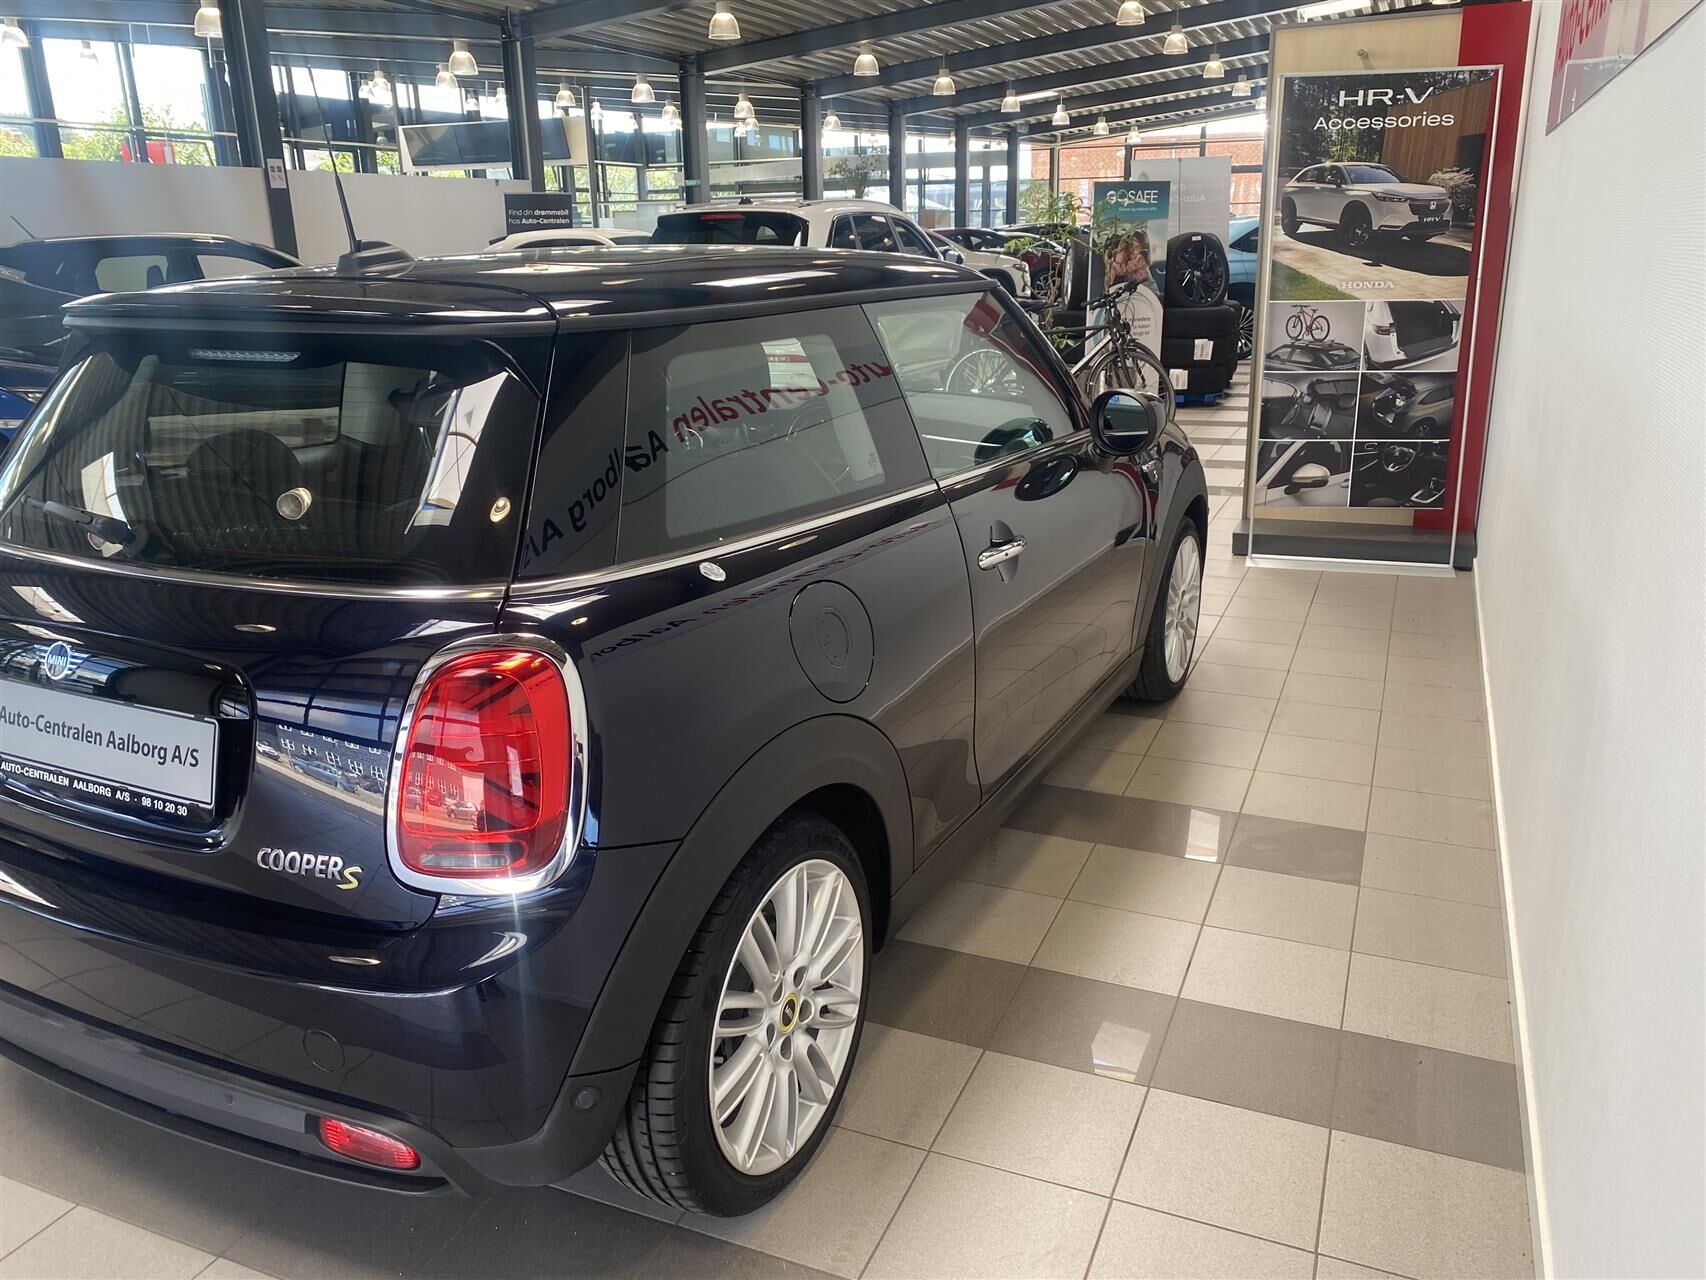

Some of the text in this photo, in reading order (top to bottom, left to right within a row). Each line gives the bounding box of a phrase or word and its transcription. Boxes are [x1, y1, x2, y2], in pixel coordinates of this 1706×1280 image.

[1338, 86, 1434, 107] HR-V
[1313, 111, 1455, 130] Accessories
[521, 217, 570, 225] Auto-Centralen
[1340, 280, 1395, 289] HONDA
[47, 654, 68, 667] MINI
[0, 705, 200, 768] Auto-Centralen Aalborg A/S
[0, 761, 188, 817] AUTO-CENTRALEN AALBORG A/S 98 10 20 30
[256, 847, 344, 880] COOPER
